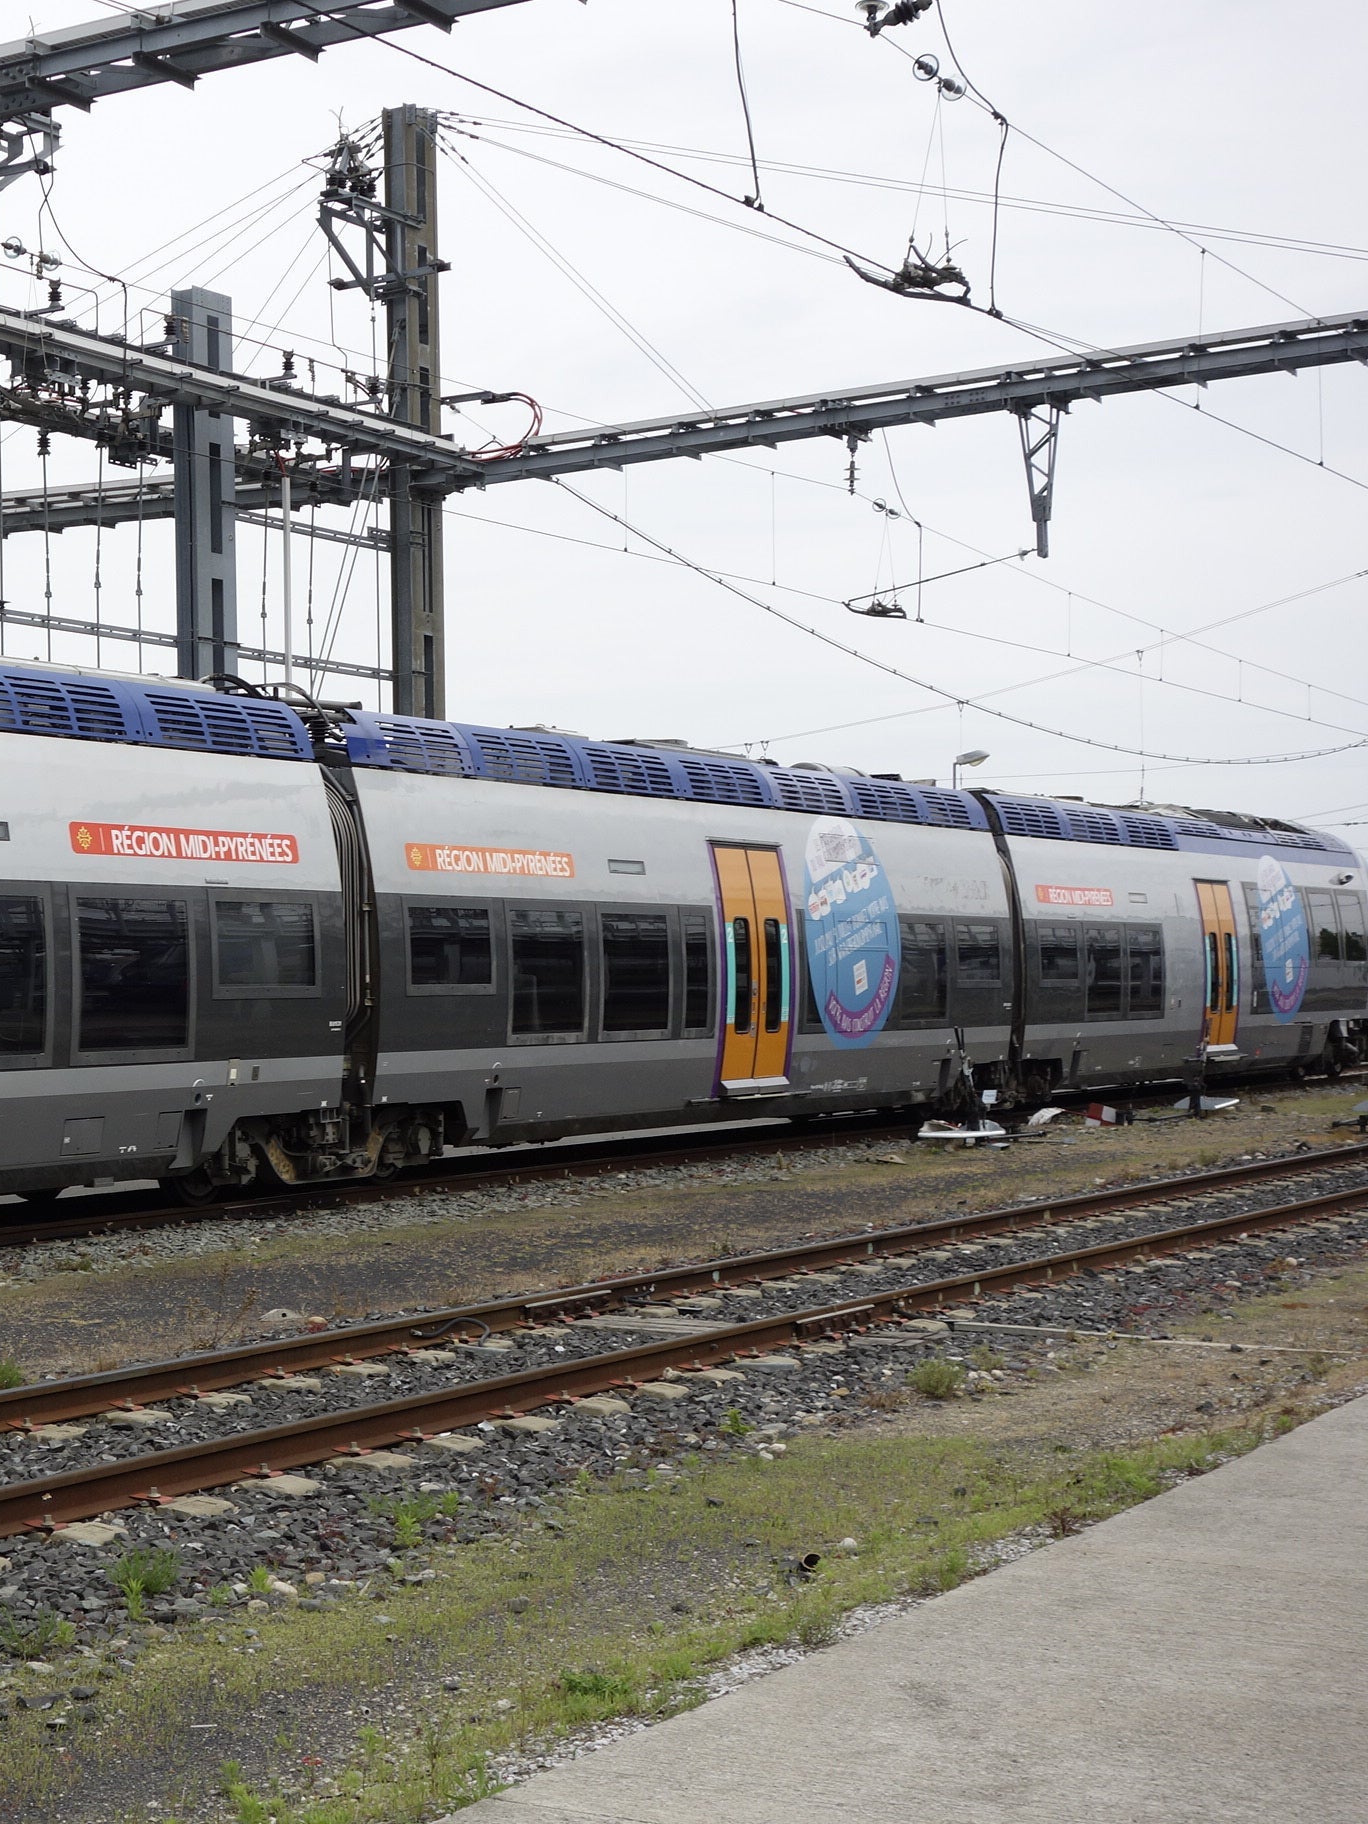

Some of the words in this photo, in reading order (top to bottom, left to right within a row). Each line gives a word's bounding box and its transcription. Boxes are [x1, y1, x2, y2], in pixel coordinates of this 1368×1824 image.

[111, 826, 177, 857] RÉGION
[179, 834, 292, 862] MIDI-PYRÉNÉES
[435, 846, 484, 872] RÉGION
[486, 851, 571, 876] MIDI-PYRÉNÉES
